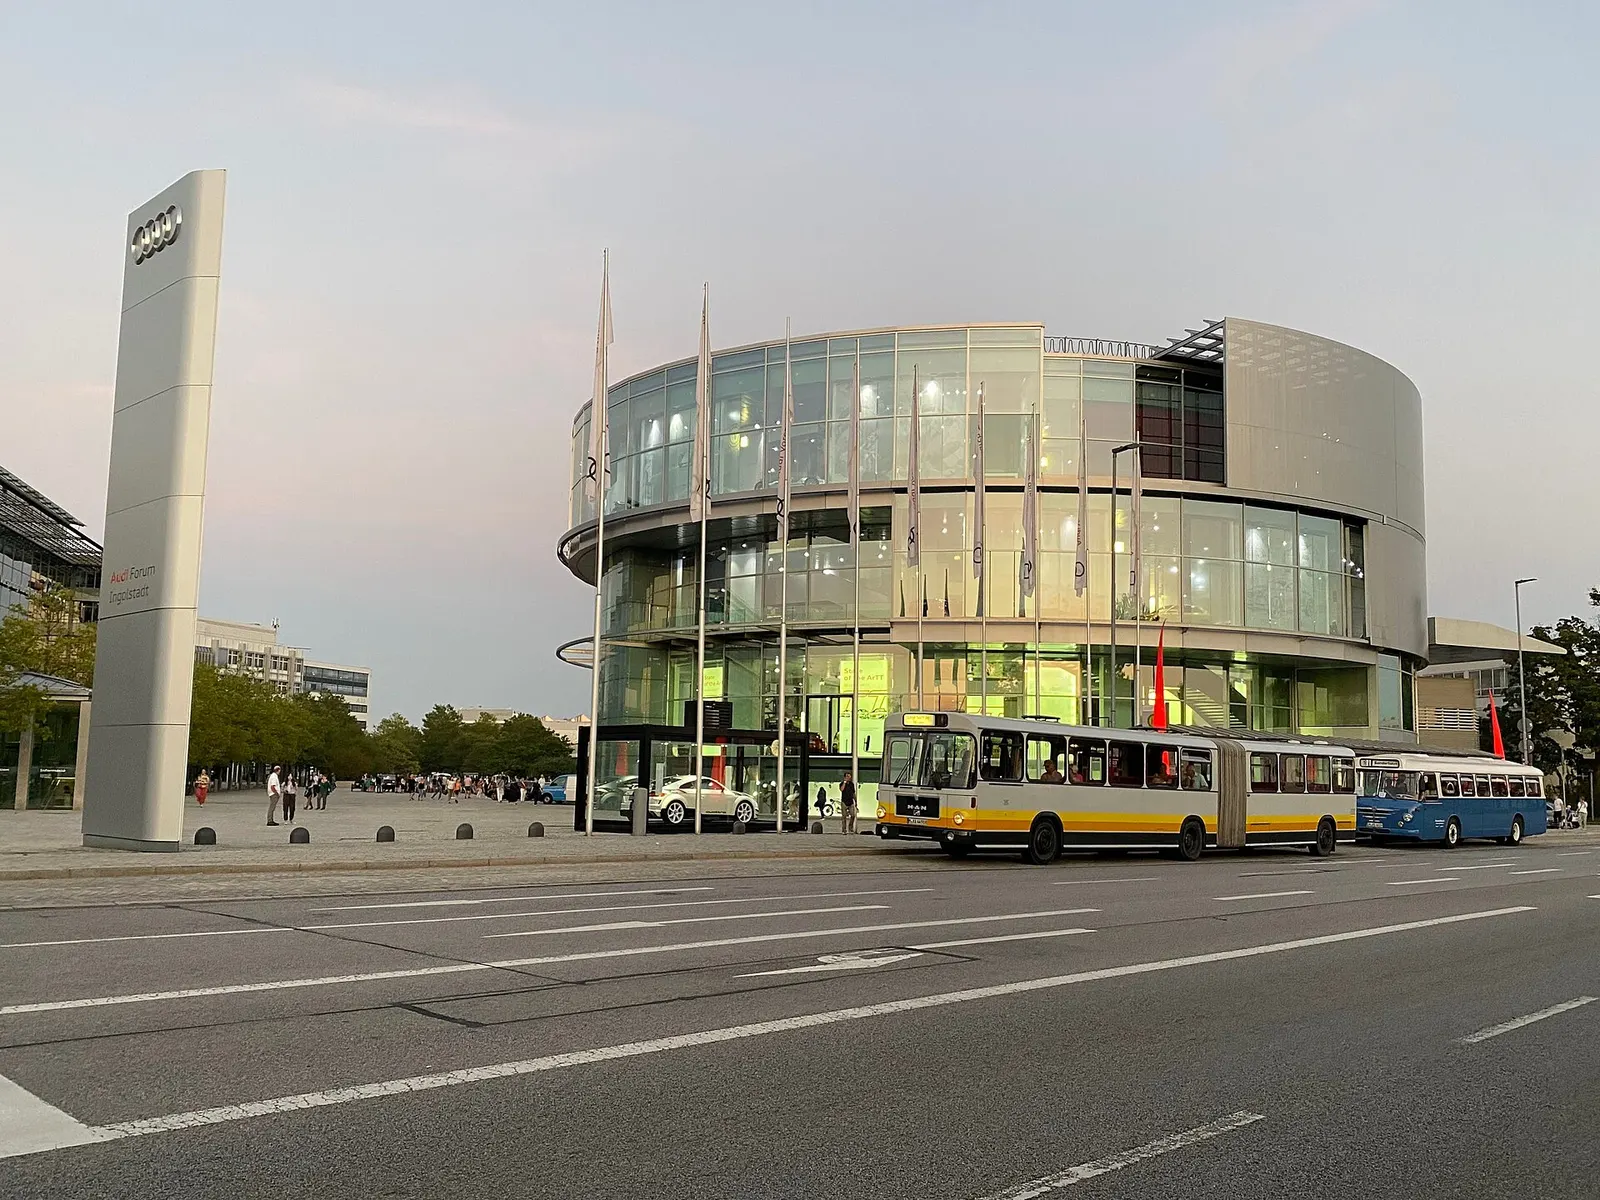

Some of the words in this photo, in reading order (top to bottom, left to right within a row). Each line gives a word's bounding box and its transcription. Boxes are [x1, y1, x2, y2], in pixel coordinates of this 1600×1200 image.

[110, 569, 129, 584] Audi
[130, 566, 156, 580] Forum
[109, 585, 149, 605] Ingolstadt
